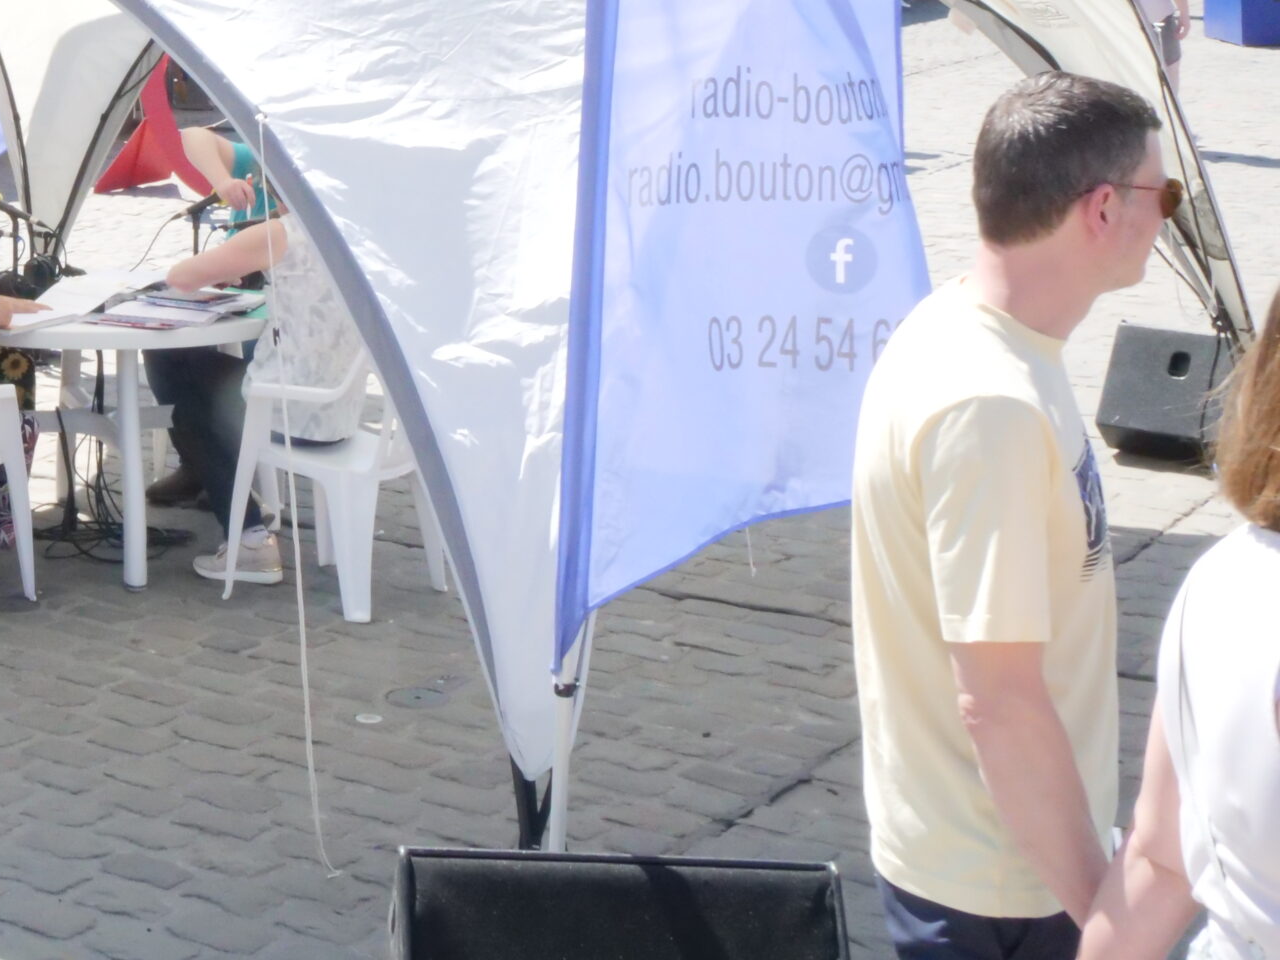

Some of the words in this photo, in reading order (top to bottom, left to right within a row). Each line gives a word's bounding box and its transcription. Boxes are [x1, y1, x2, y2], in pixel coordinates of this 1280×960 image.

[708, 315, 743, 371] 03
[758, 315, 799, 369] 24
[814, 317, 857, 372] 54
